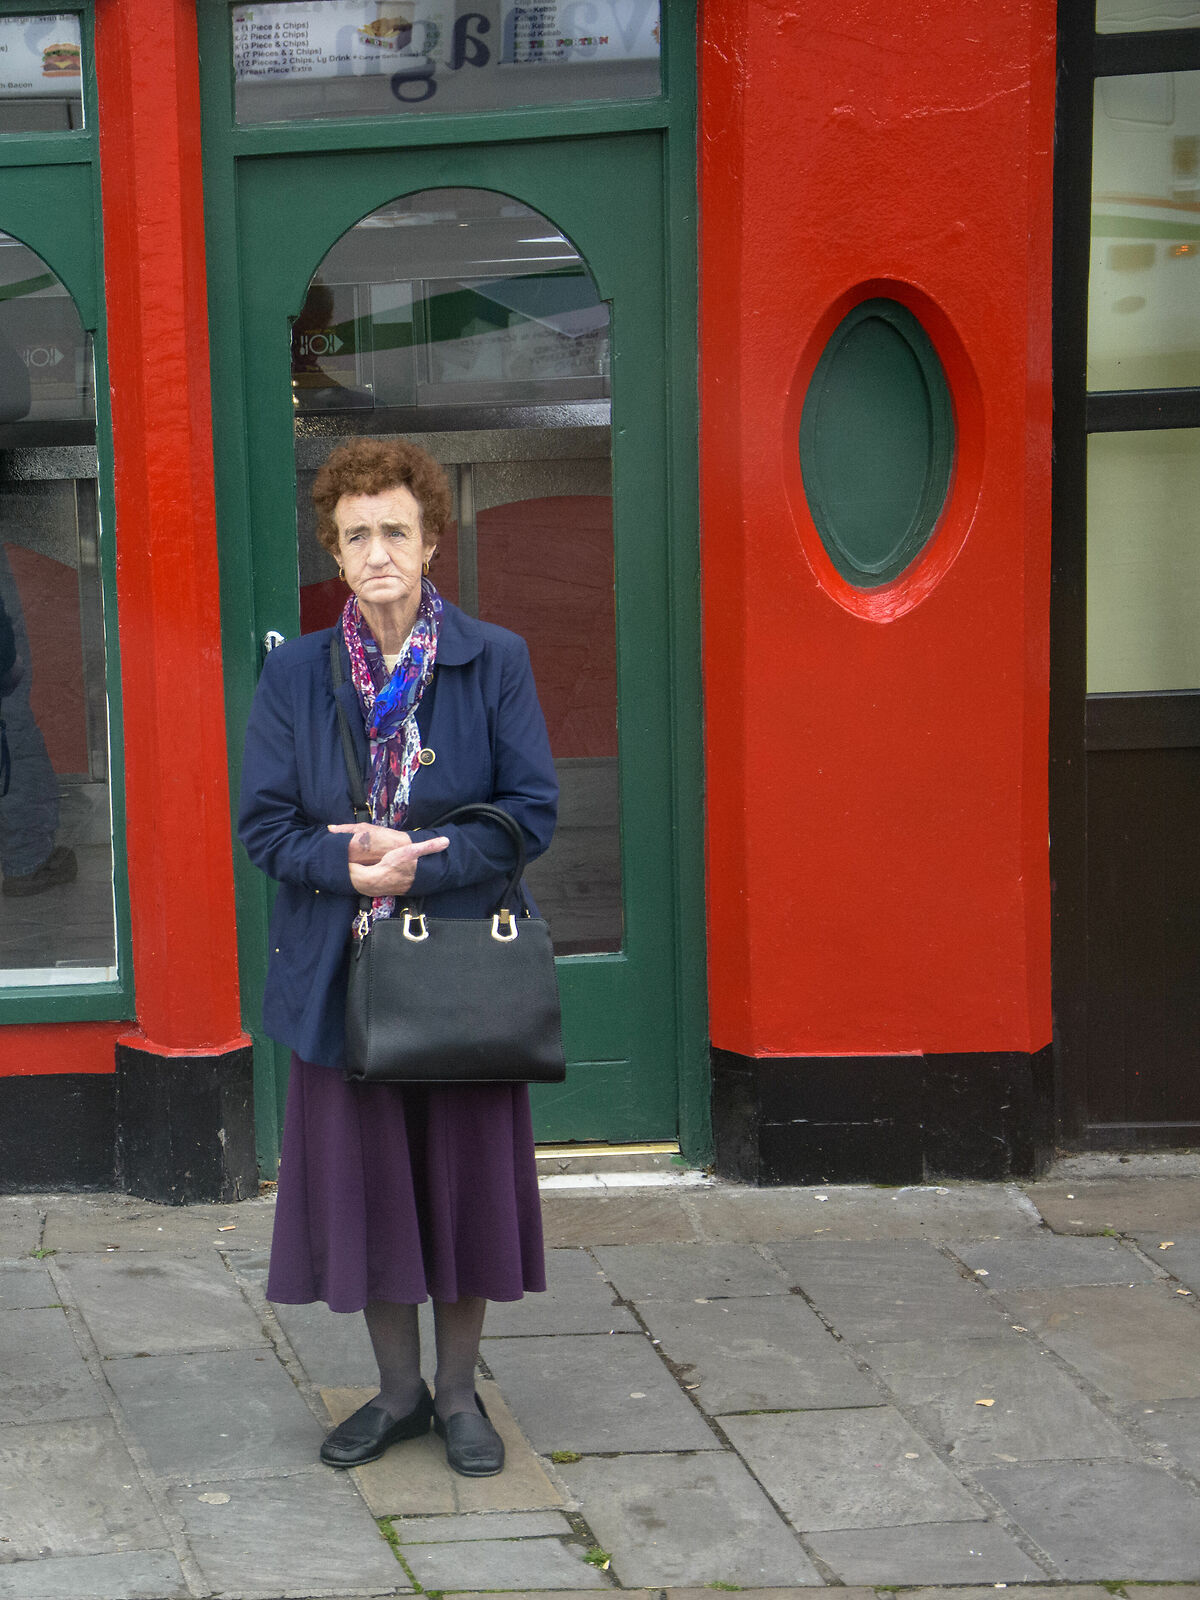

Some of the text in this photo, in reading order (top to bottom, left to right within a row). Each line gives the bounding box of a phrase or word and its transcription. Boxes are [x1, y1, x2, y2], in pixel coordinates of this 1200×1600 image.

[283, 21, 309, 30] Chips)
[282, 31, 308, 39] Chips)
[283, 40, 309, 48] Chips)
[296, 47, 322, 55] Chips)
[289, 57, 315, 65] Chips,
[329, 54, 351, 62] Drink
[7, 81, 33, 89] Bacon
